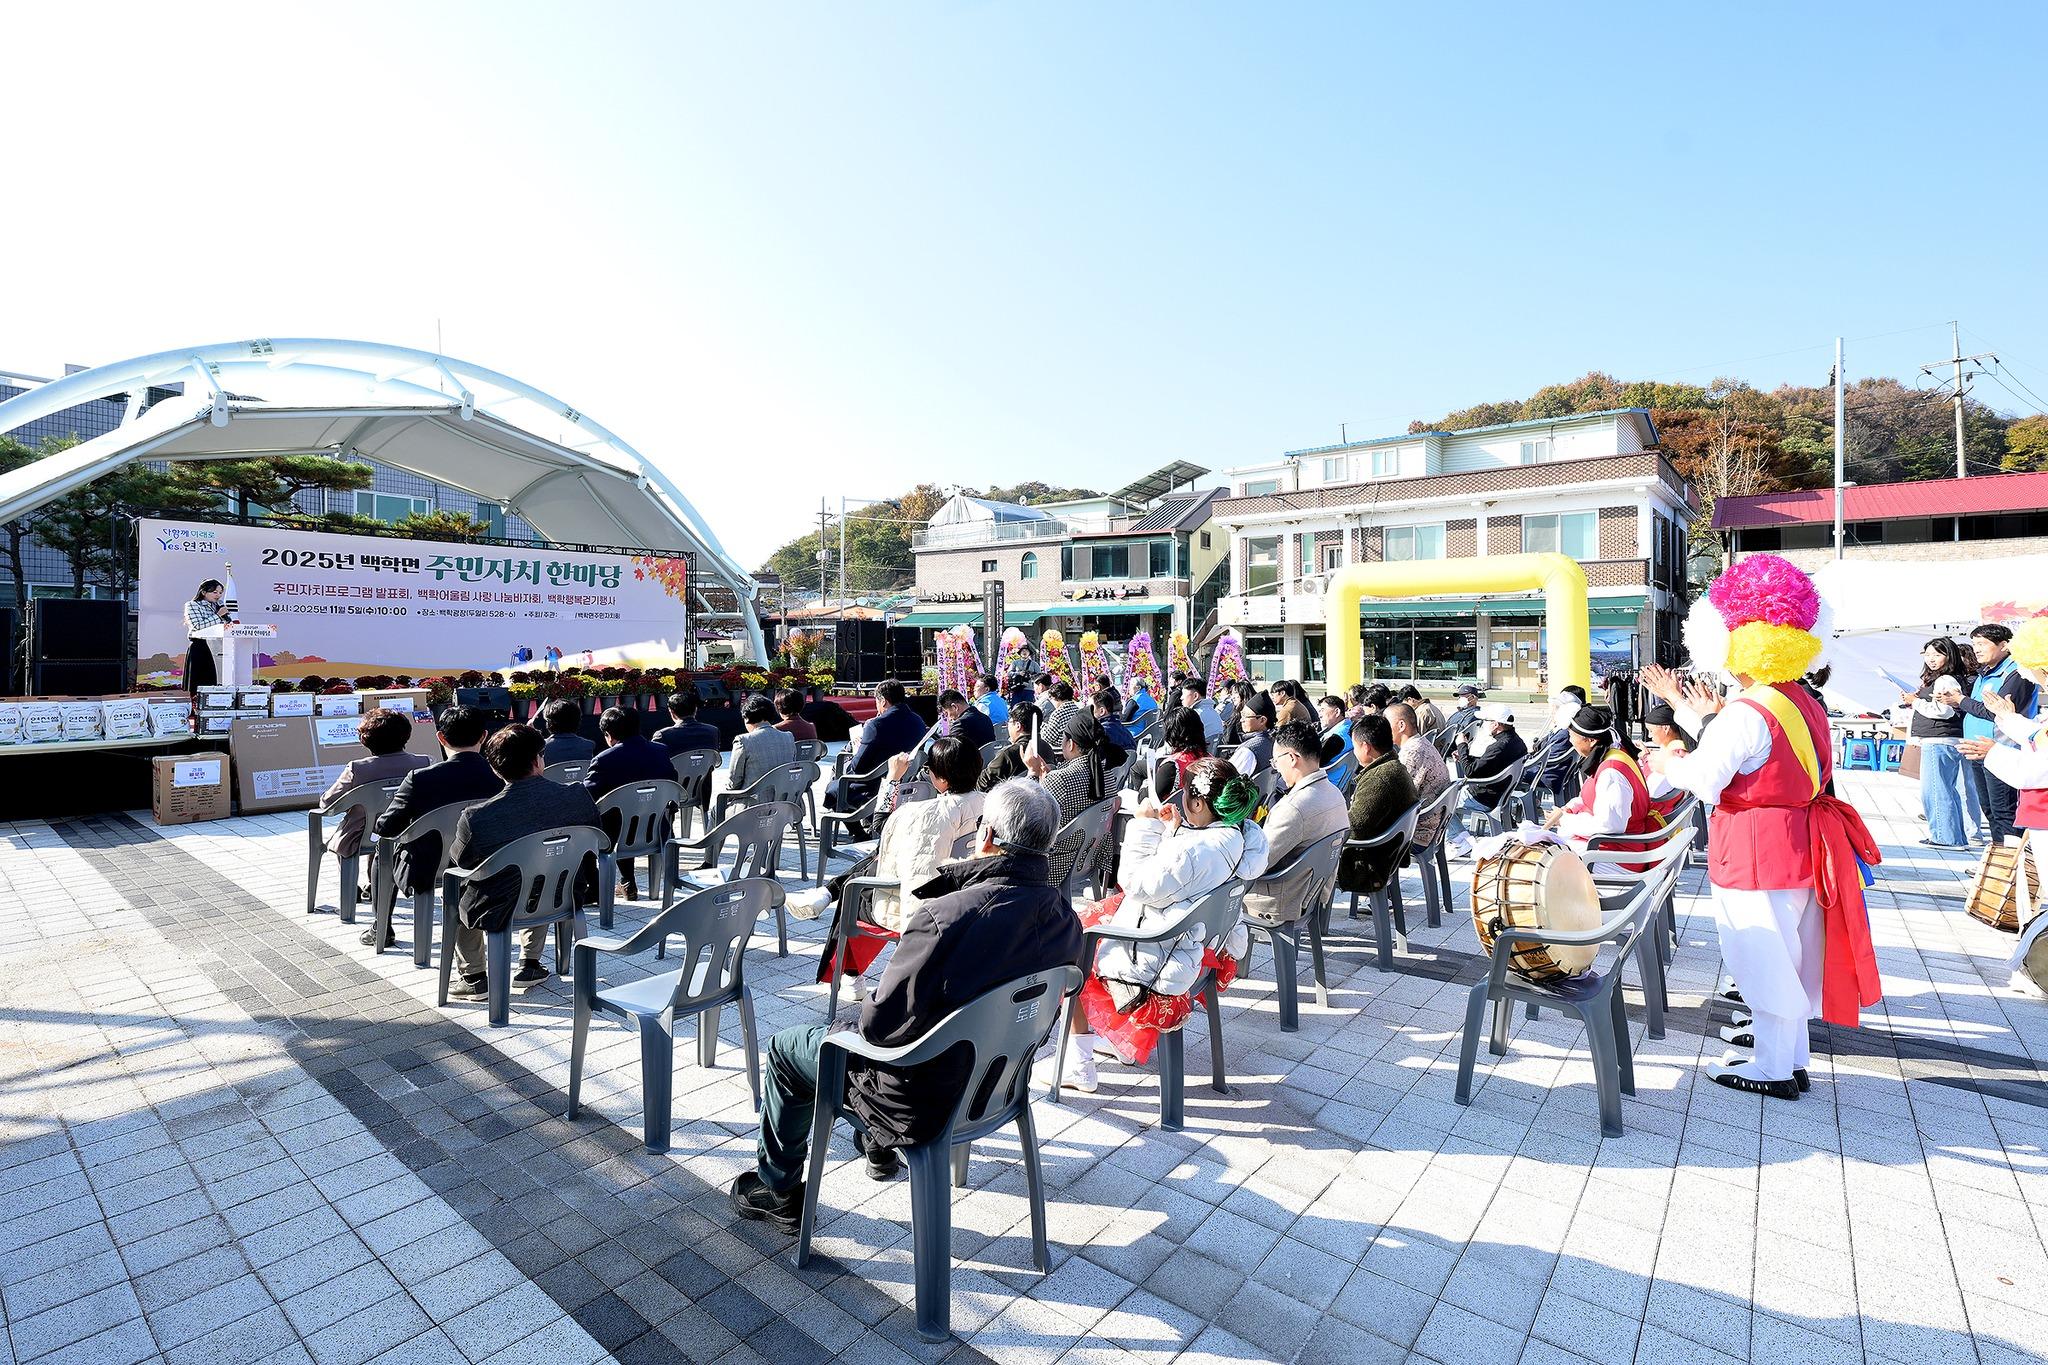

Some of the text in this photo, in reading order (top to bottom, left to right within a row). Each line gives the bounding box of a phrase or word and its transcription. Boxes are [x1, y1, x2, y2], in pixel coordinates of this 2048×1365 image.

[163, 528, 215, 539] 다함께 미래로
[261, 548, 623, 588] 2025년 백학면 주민자치 한마당
[273, 582, 616, 605] 주민자치프로그램 발표회, 백학어울림 사랑 나눔바자회, 백학행복걷기행사
[329, 605, 346, 615] 11월
[256, 774, 270, 782] 65
